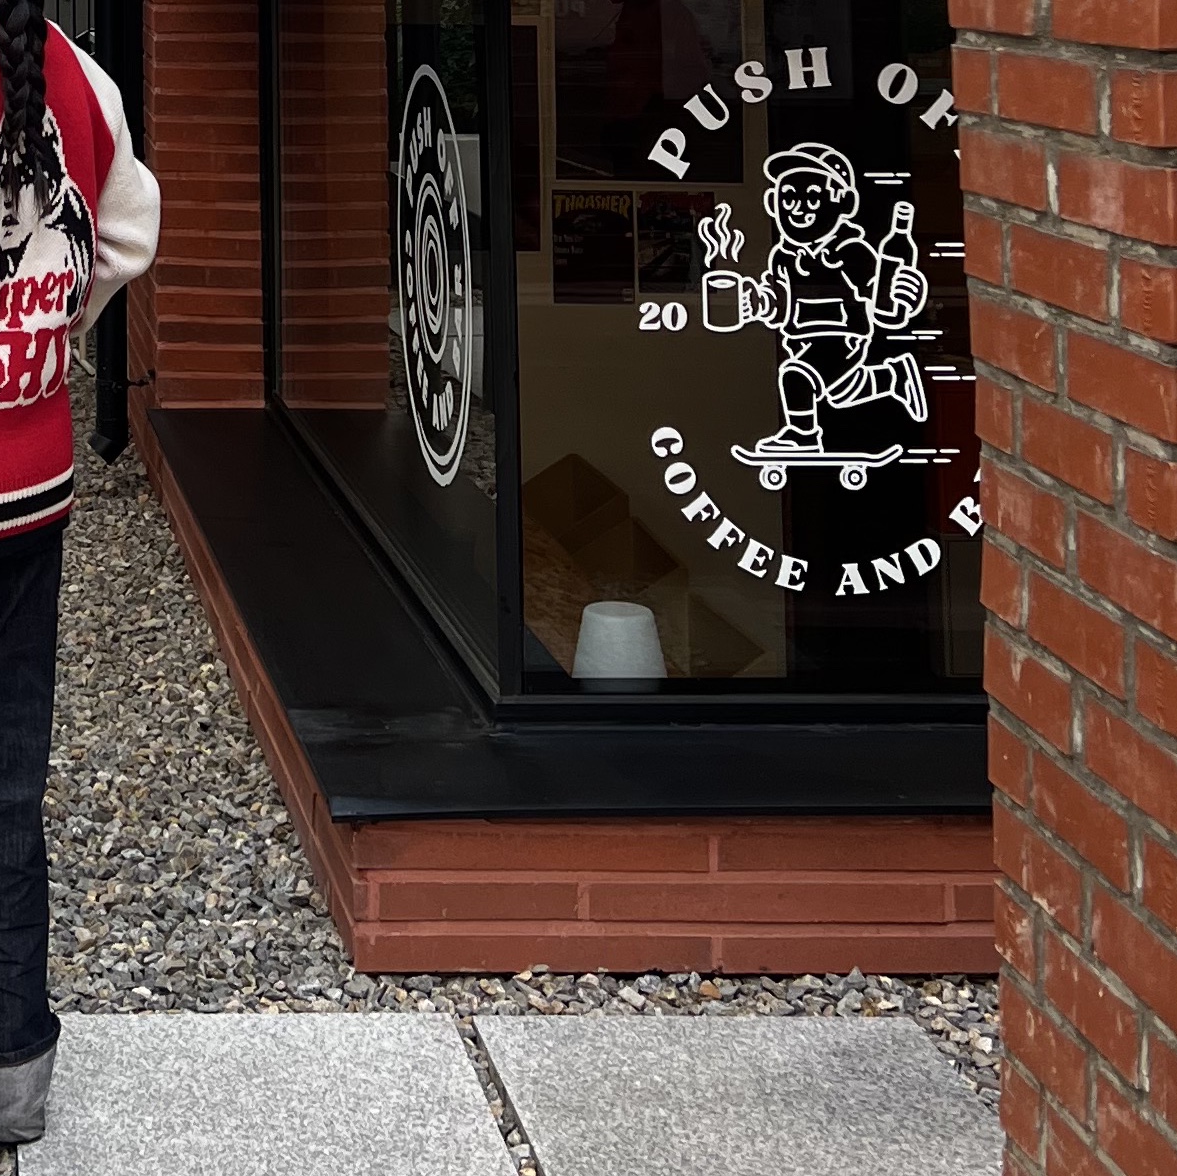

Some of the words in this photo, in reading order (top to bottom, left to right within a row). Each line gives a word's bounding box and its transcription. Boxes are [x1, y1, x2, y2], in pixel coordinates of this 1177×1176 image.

[405, 106, 433, 208] PUSH
[647, 46, 832, 180] PUSH
[877, 62, 961, 160] OF
[638, 301, 688, 332] 20
[651, 426, 810, 592] COFFEE
[834, 537, 942, 597] AND
